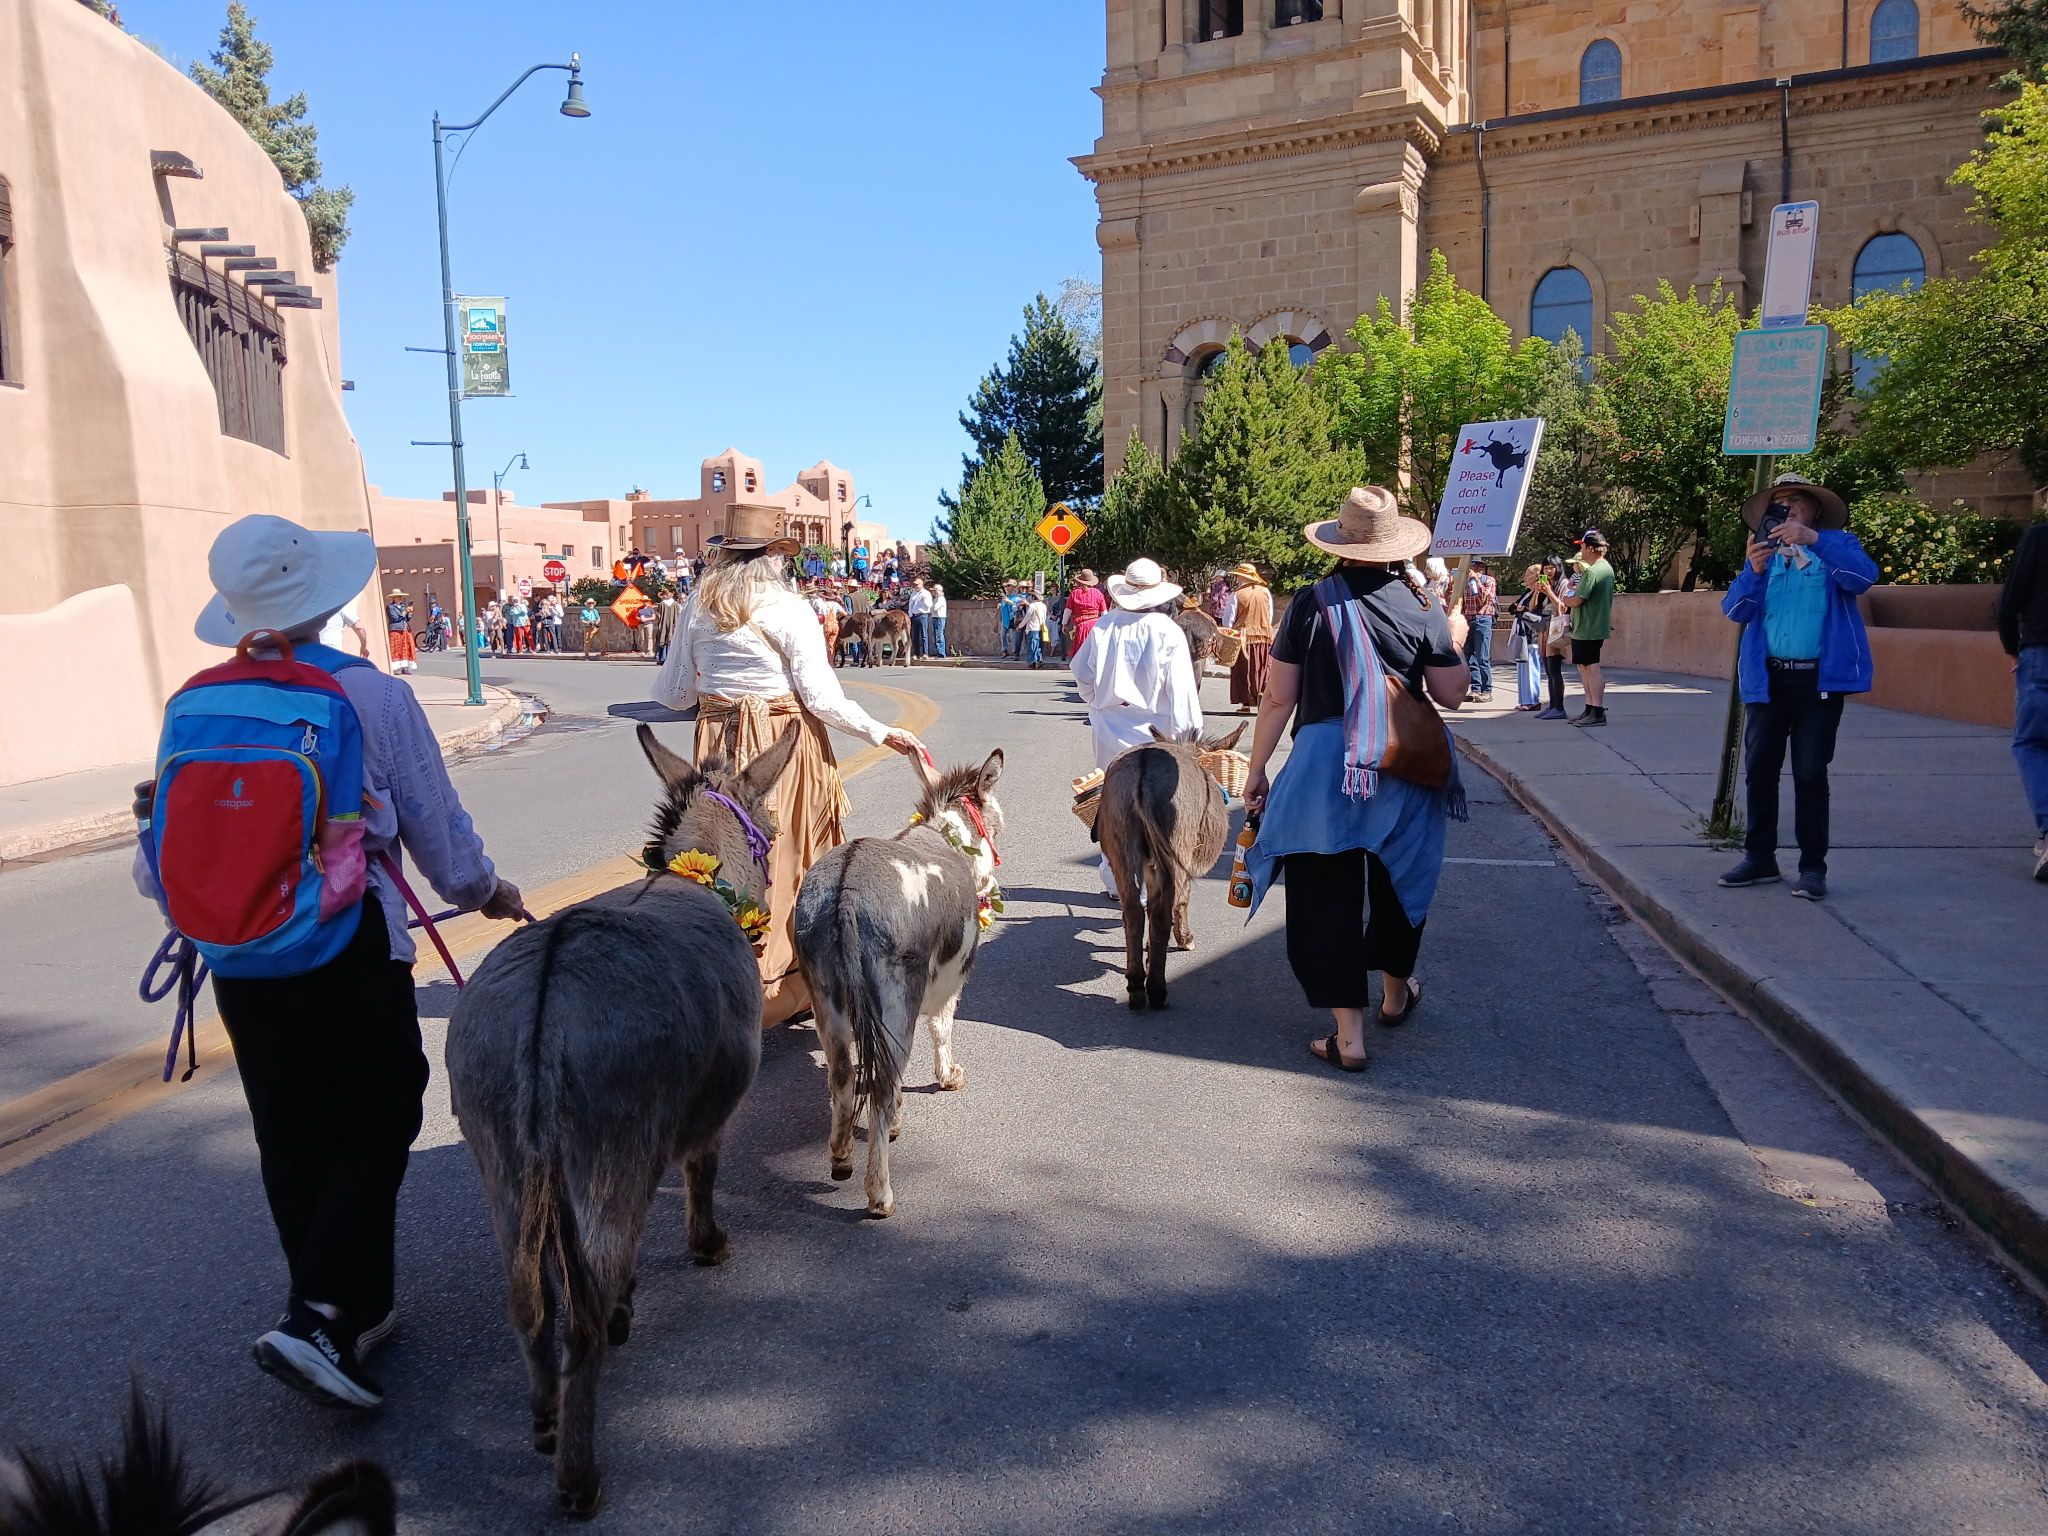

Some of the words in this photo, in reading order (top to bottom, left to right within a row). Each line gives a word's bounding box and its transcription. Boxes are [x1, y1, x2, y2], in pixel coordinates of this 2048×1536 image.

[1792, 227, 1810, 235] STOP
[1743, 335, 1816, 353] LOADING
[1757, 355, 1798, 372] ZONE
[471, 369, 479, 380] La
[480, 369, 502, 383] Fonda
[1458, 470, 1496, 482] Please
[1458, 486, 1487, 498] don't
[1451, 504, 1486, 515] crowd
[1455, 520, 1474, 531] the
[1435, 538, 1484, 549] donkeys.
[544, 567, 565, 577] STOP
[310, 1328, 340, 1365] HOKA
